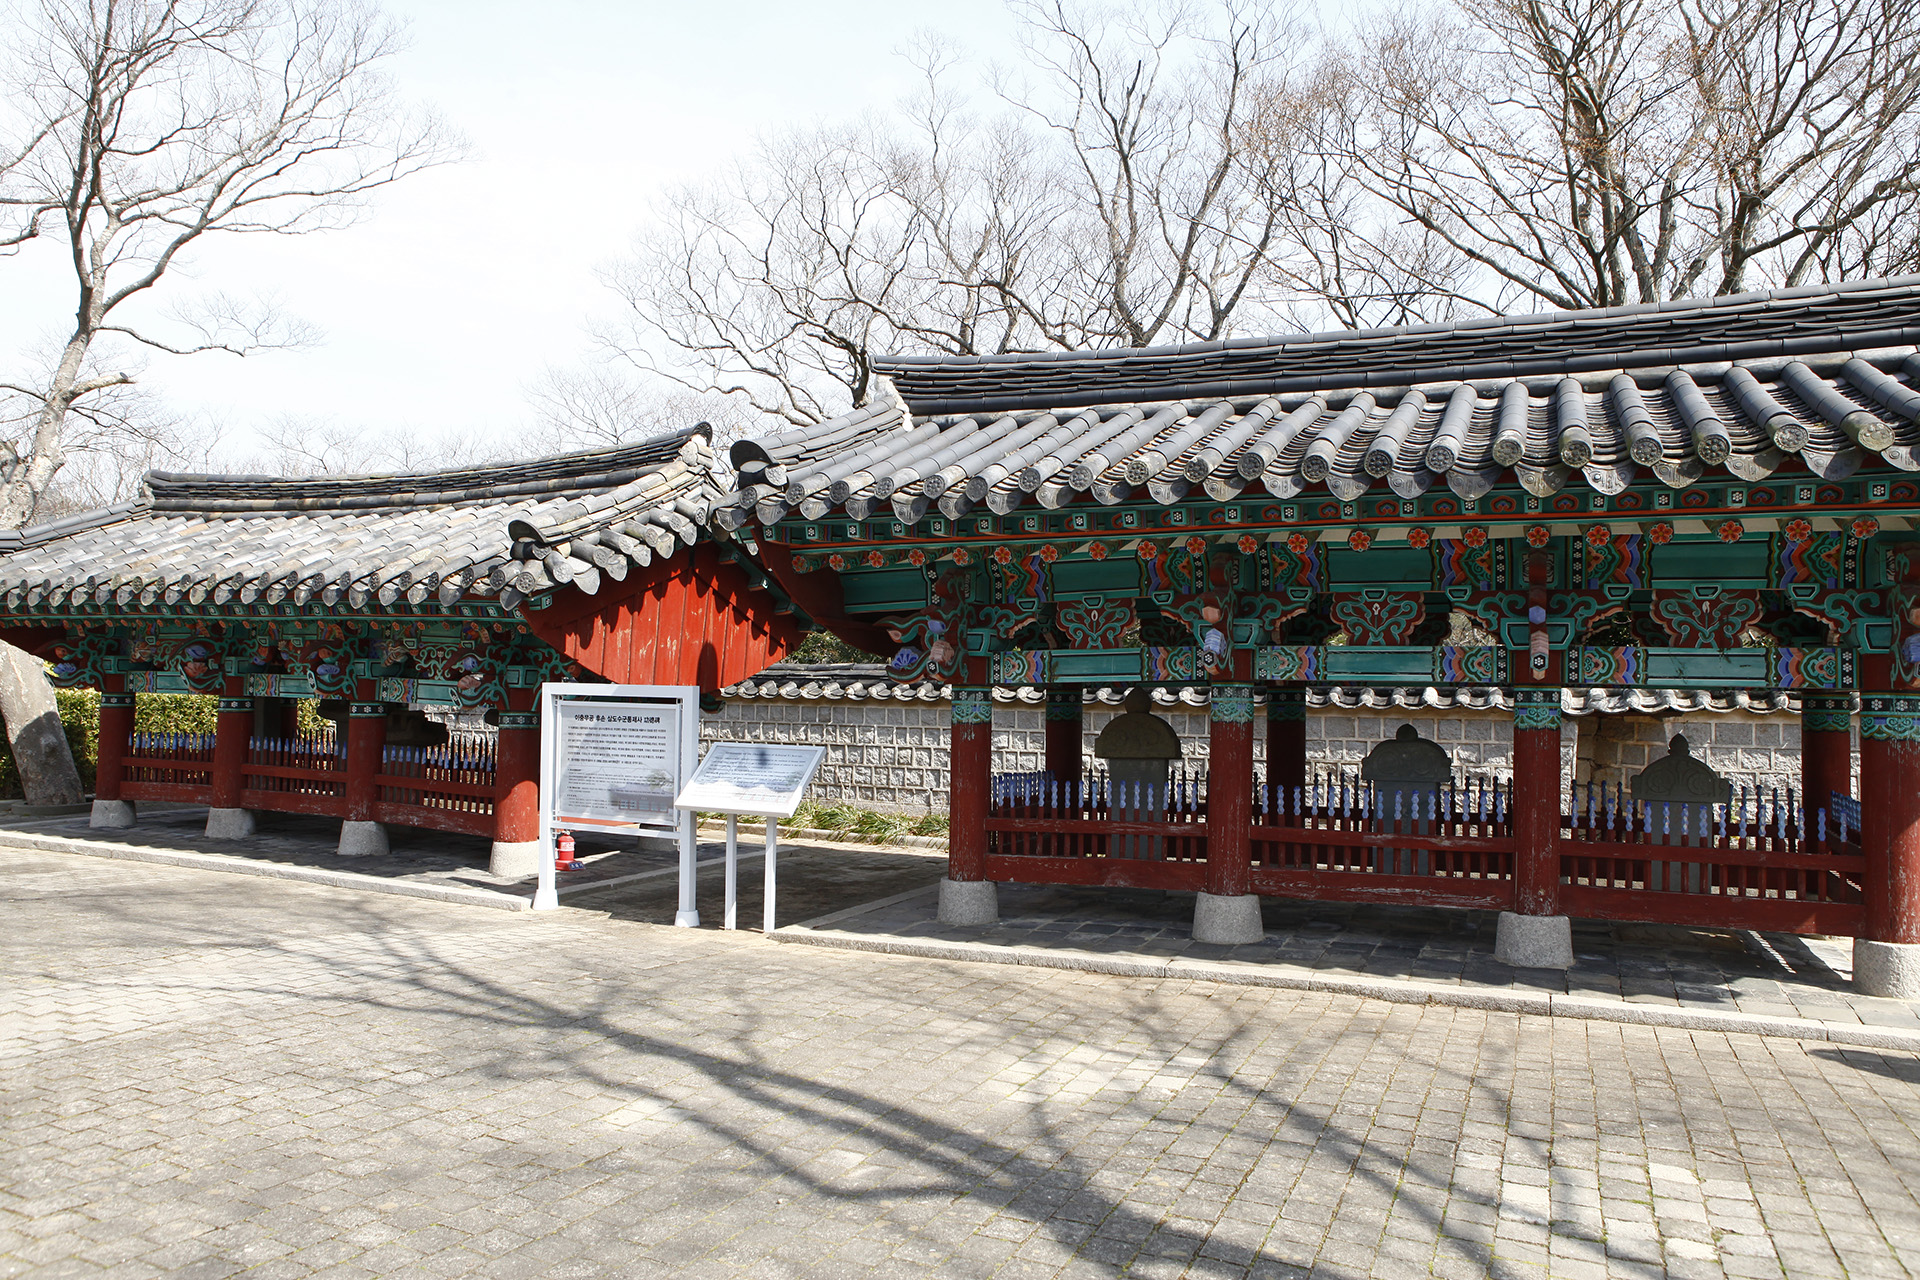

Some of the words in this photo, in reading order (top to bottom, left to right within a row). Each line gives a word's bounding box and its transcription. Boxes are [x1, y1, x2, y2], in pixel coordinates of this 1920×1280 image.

[574, 714, 594, 723] 이충무공
[596, 714, 606, 723] 후손
[607, 715, 643, 723] 삼도수군통제사
